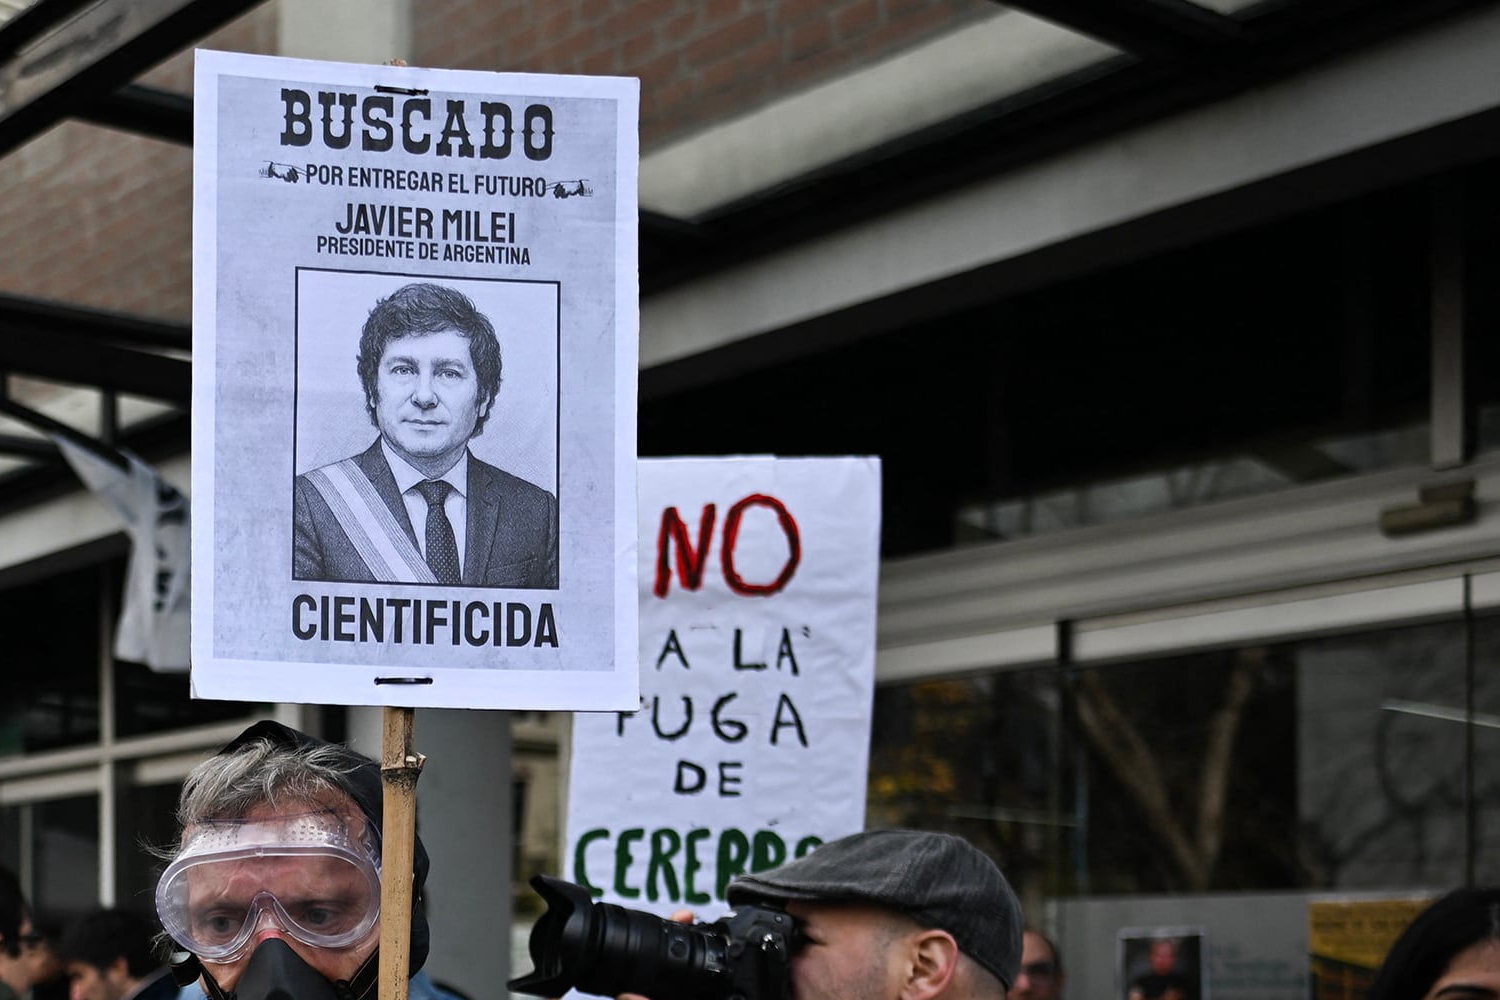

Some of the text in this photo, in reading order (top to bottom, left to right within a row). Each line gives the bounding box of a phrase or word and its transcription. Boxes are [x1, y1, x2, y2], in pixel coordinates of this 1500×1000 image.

[281, 87, 555, 161] BUSCADO
[306, 164, 546, 197] POR ENTREGAR EL FUTURO
[336, 203, 514, 243] JAVIER MILEI
[317, 234, 530, 265] PRESIDENTE DE ARGENTINA
[654, 493, 801, 597] NO
[292, 594, 559, 648] CIENTIFICIDA
[657, 627, 799, 676] A LA
[674, 760, 742, 797] DE
